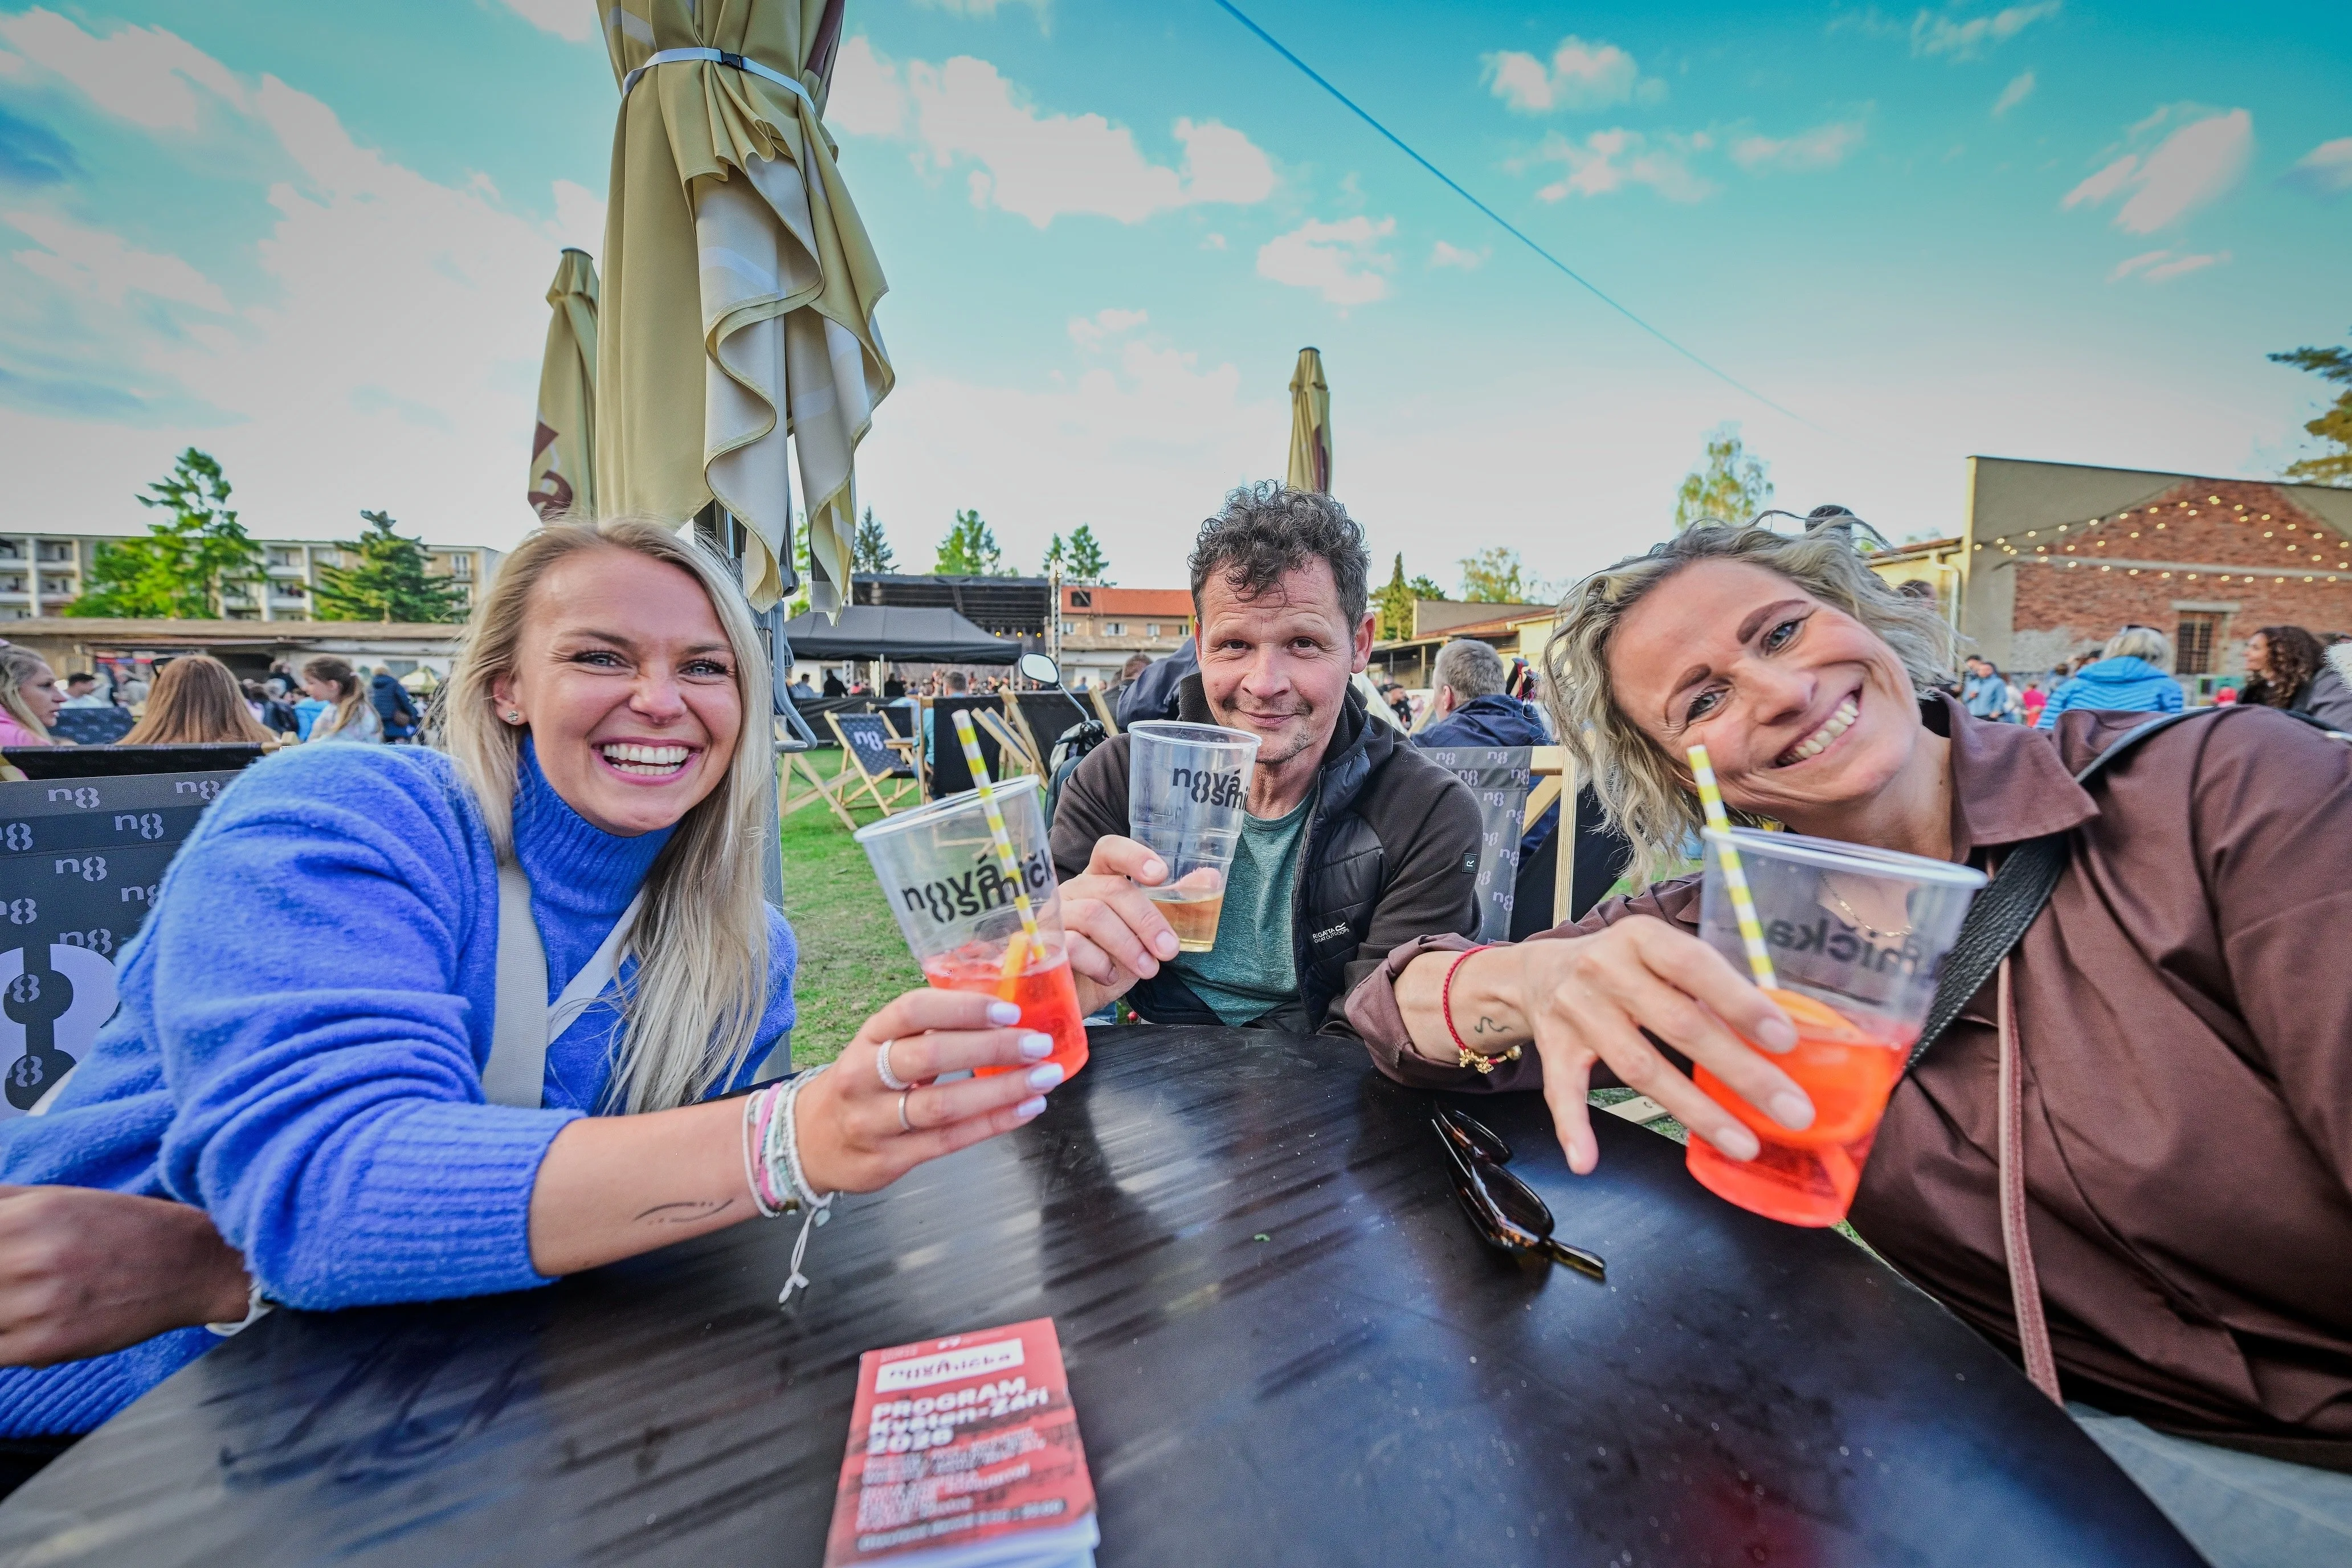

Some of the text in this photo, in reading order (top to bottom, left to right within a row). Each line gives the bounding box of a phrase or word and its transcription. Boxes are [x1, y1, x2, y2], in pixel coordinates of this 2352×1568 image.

[854, 730, 884, 752] n8
[1436, 752, 1456, 765] n8
[1488, 751, 1508, 764] n8
[48, 787, 100, 808] n8
[175, 781, 220, 800] n8
[1483, 791, 1504, 807] n8
[115, 813, 164, 839] n8
[0, 823, 33, 851] 8
[55, 856, 107, 881] n8
[59, 928, 112, 954] n8
